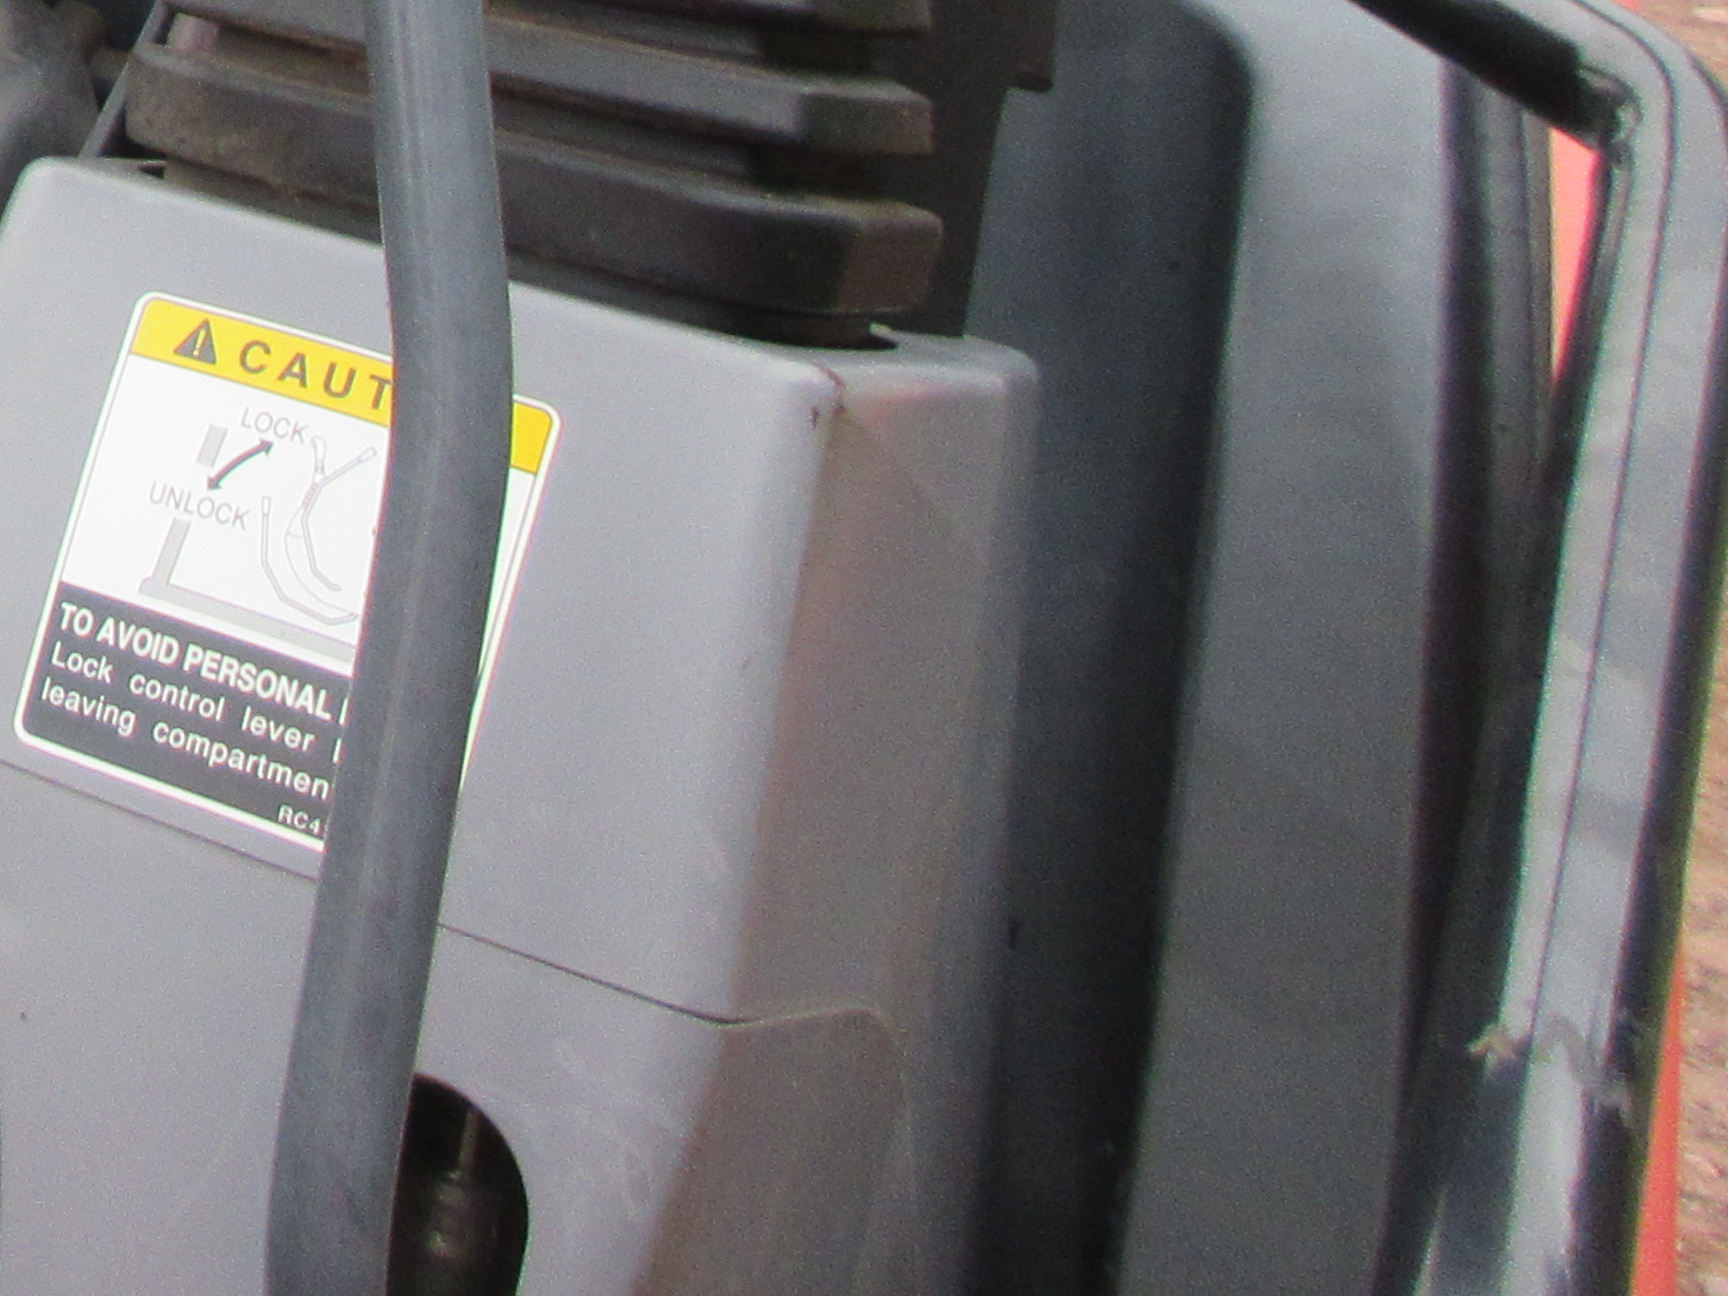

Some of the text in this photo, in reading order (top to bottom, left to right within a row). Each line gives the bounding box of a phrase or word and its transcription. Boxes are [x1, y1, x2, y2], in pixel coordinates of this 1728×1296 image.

[239, 340, 393, 410] CAUT
[241, 406, 309, 445] LOCK
[149, 481, 250, 531] UNLOCK
[60, 601, 94, 637] TO
[97, 616, 180, 665] AVOID
[182, 644, 332, 721] PERSONAL
[51, 641, 113, 684] Lock
[129, 672, 226, 722] control
[242, 705, 317, 752] lever
[42, 676, 330, 801] leaving compartmen
[277, 804, 321, 834] RC4
